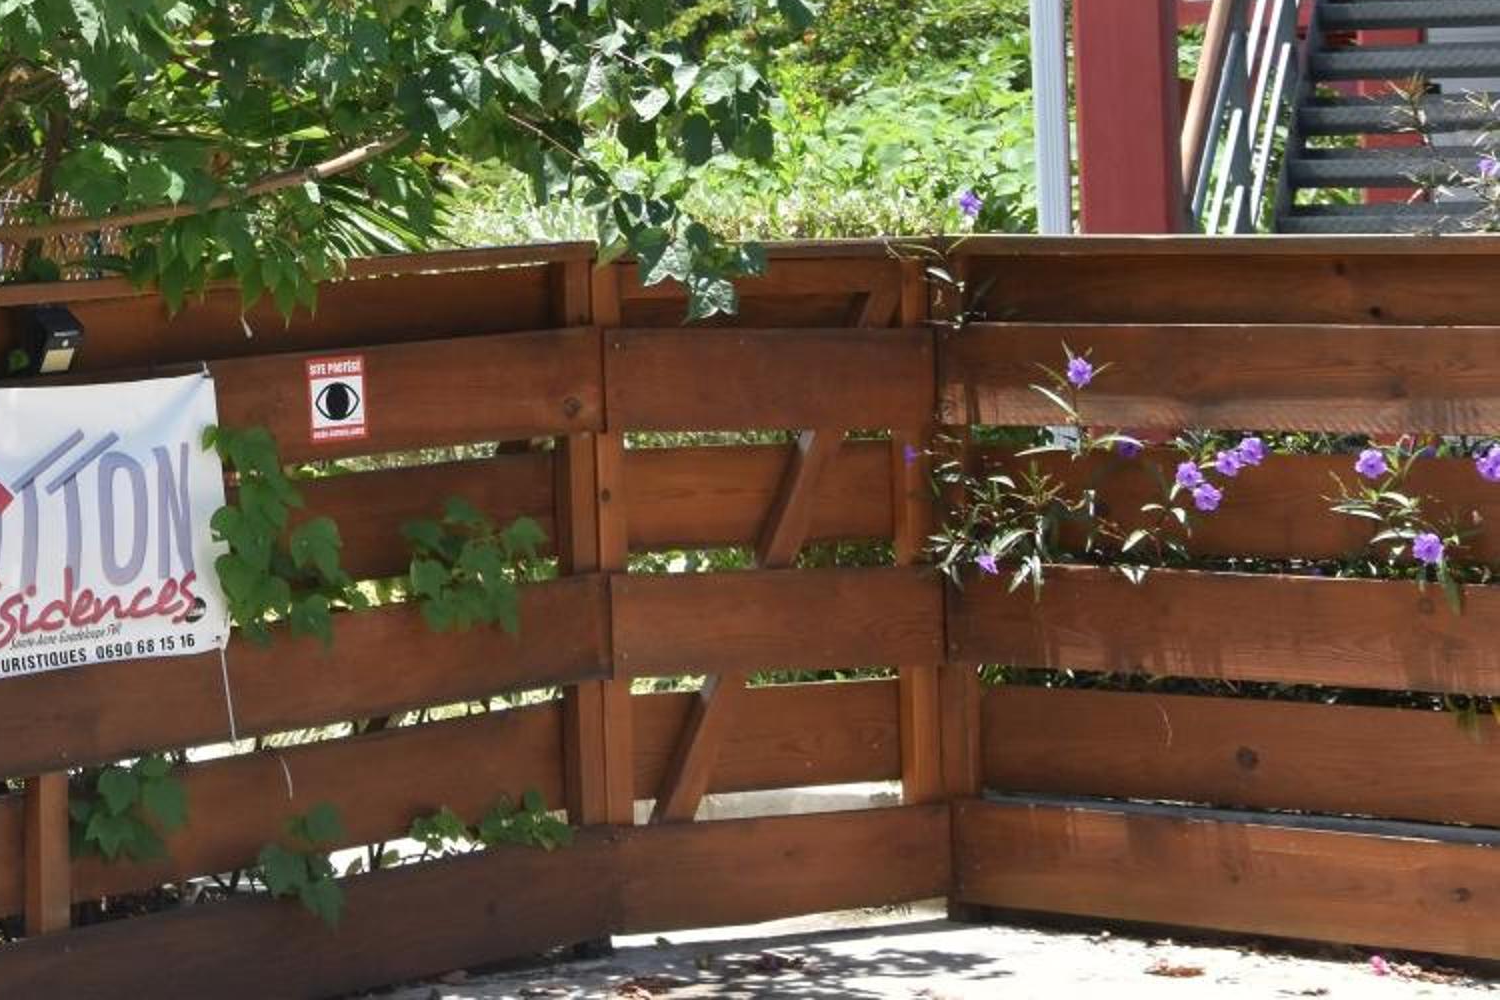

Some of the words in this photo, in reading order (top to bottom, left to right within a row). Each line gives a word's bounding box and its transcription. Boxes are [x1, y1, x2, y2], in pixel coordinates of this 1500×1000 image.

[95, 639, 133, 661] 0690
[137, 638, 156, 655] 68
[160, 635, 176, 651] 15
[180, 633, 196, 649] 16
